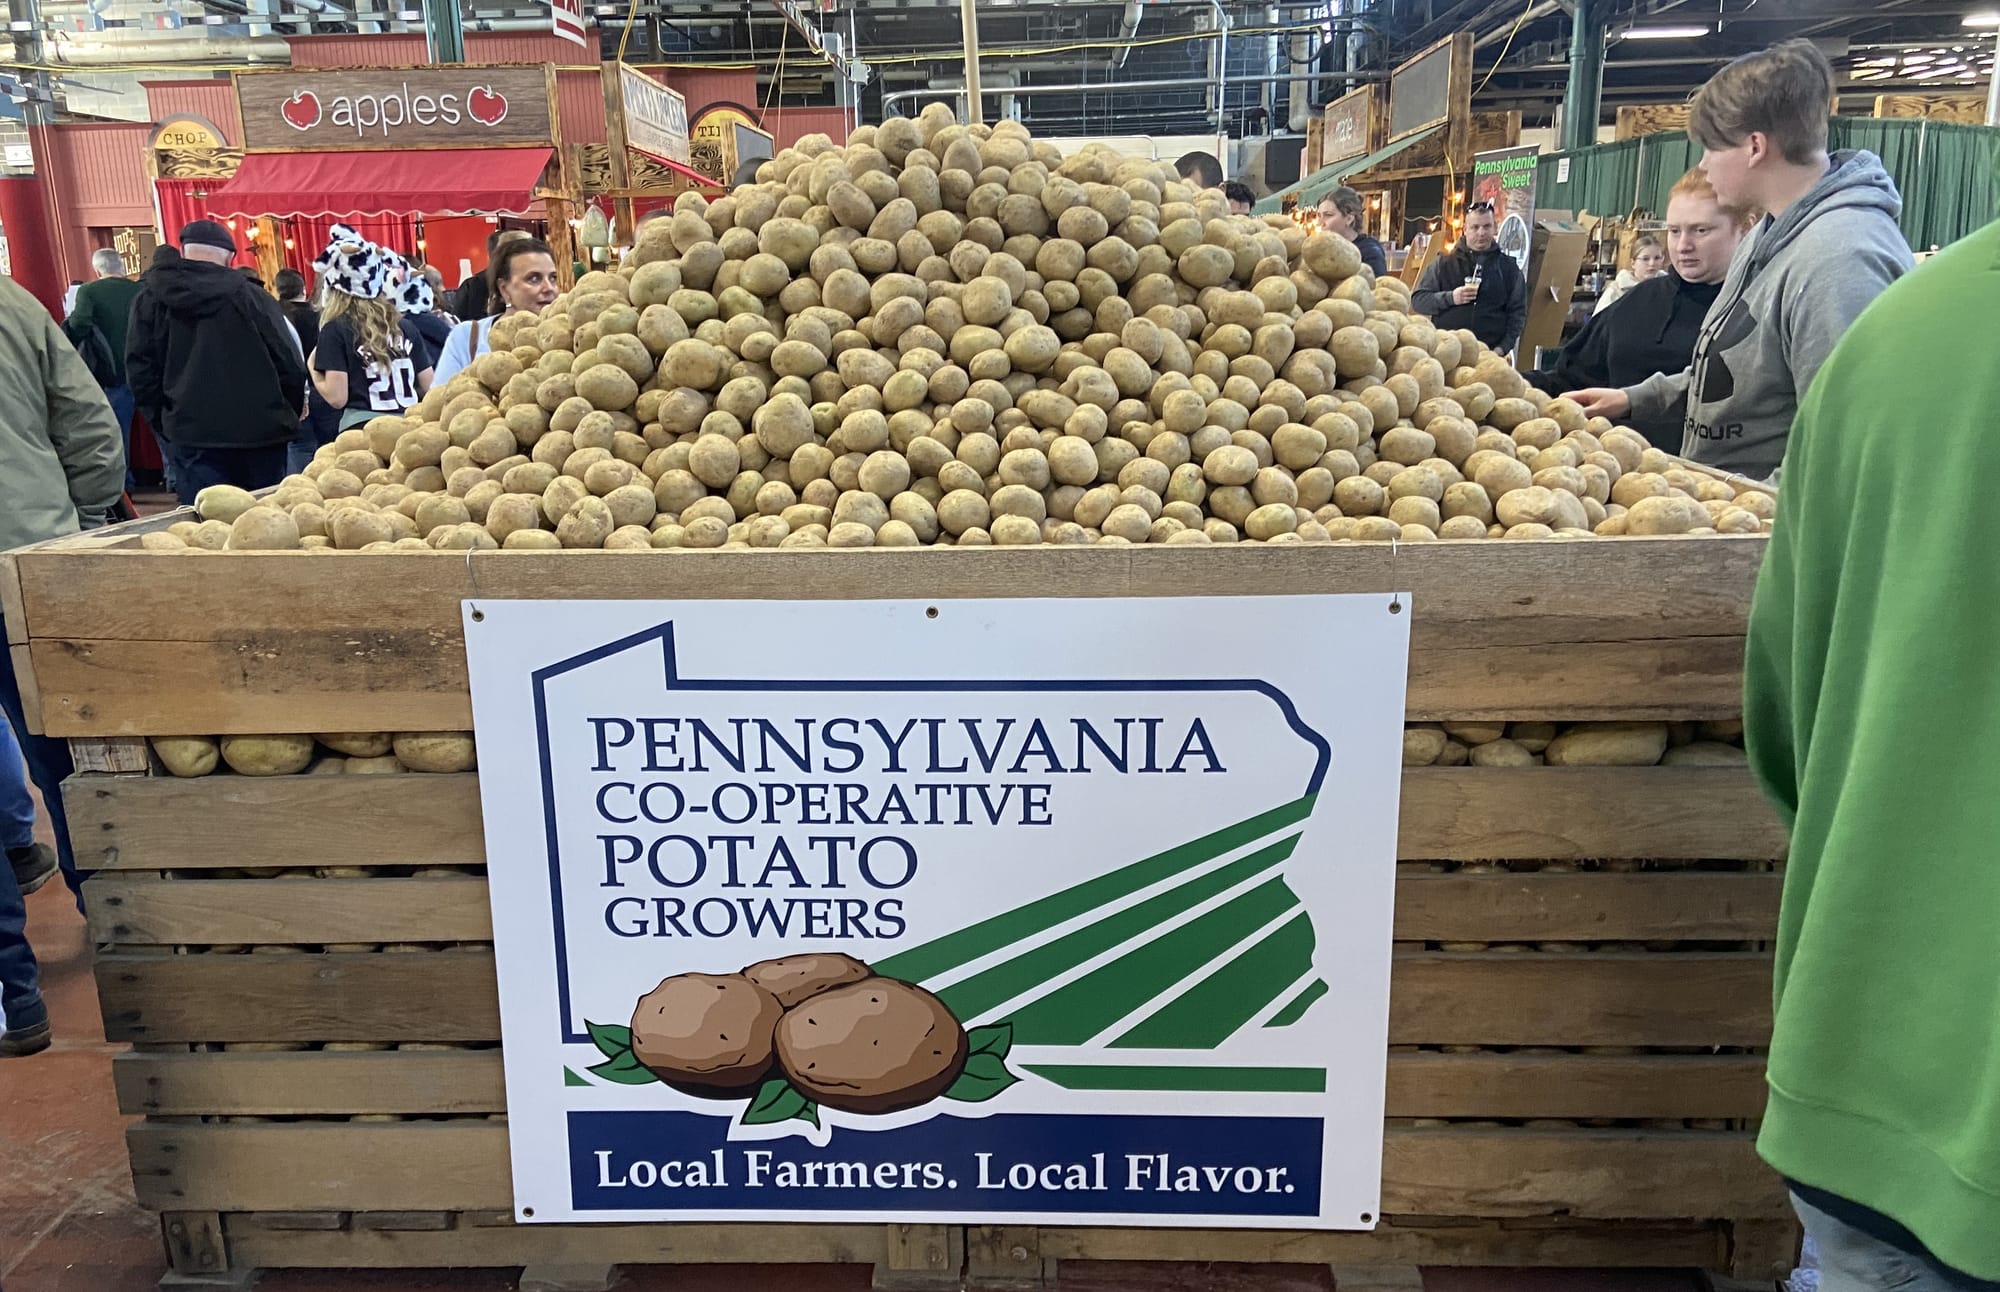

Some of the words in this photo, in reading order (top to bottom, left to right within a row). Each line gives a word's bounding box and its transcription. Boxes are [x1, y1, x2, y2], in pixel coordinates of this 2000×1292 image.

[331, 81, 461, 137] apples
[162, 132, 208, 146] CHOP
[1474, 151, 1538, 177] Pennsylvania
[1502, 171, 1532, 189] Sweet
[365, 358, 418, 410] 20
[587, 717, 1228, 774] PENNSYLVANIA
[595, 781, 1053, 826] CO-OPERATIVE
[597, 834, 918, 890] POTATO
[604, 896, 907, 940] GROWERS
[594, 1149, 729, 1188] Local
[743, 1150, 958, 1189] Farmers.
[974, 1152, 1108, 1191] Local
[1124, 1154, 1296, 1194] Flavor.
